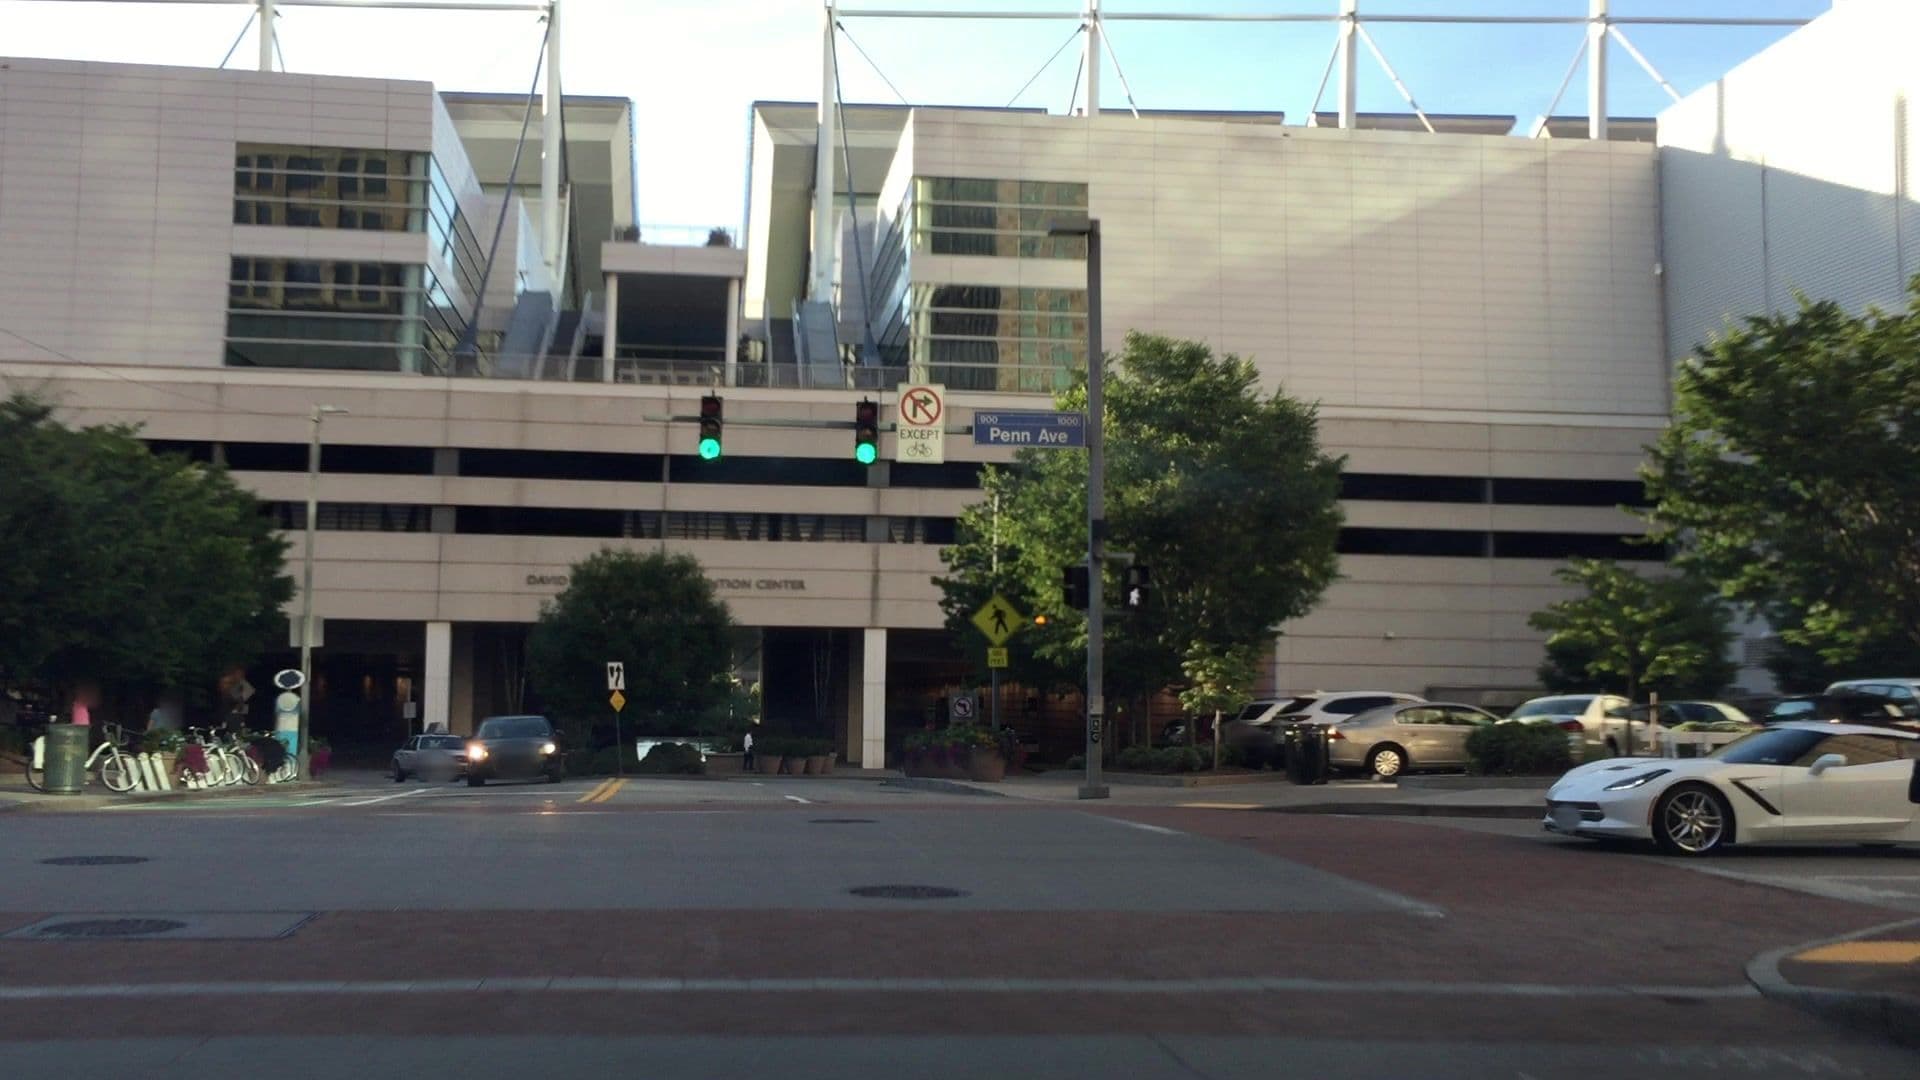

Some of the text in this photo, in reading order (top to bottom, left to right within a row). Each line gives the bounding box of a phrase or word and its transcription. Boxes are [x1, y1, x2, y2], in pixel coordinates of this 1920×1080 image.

[980, 415, 1079, 426] 900 1000
[900, 429, 939, 440] EXCEPT
[989, 427, 1069, 443] Penn Ave
[756, 580, 806, 590] CENTER
